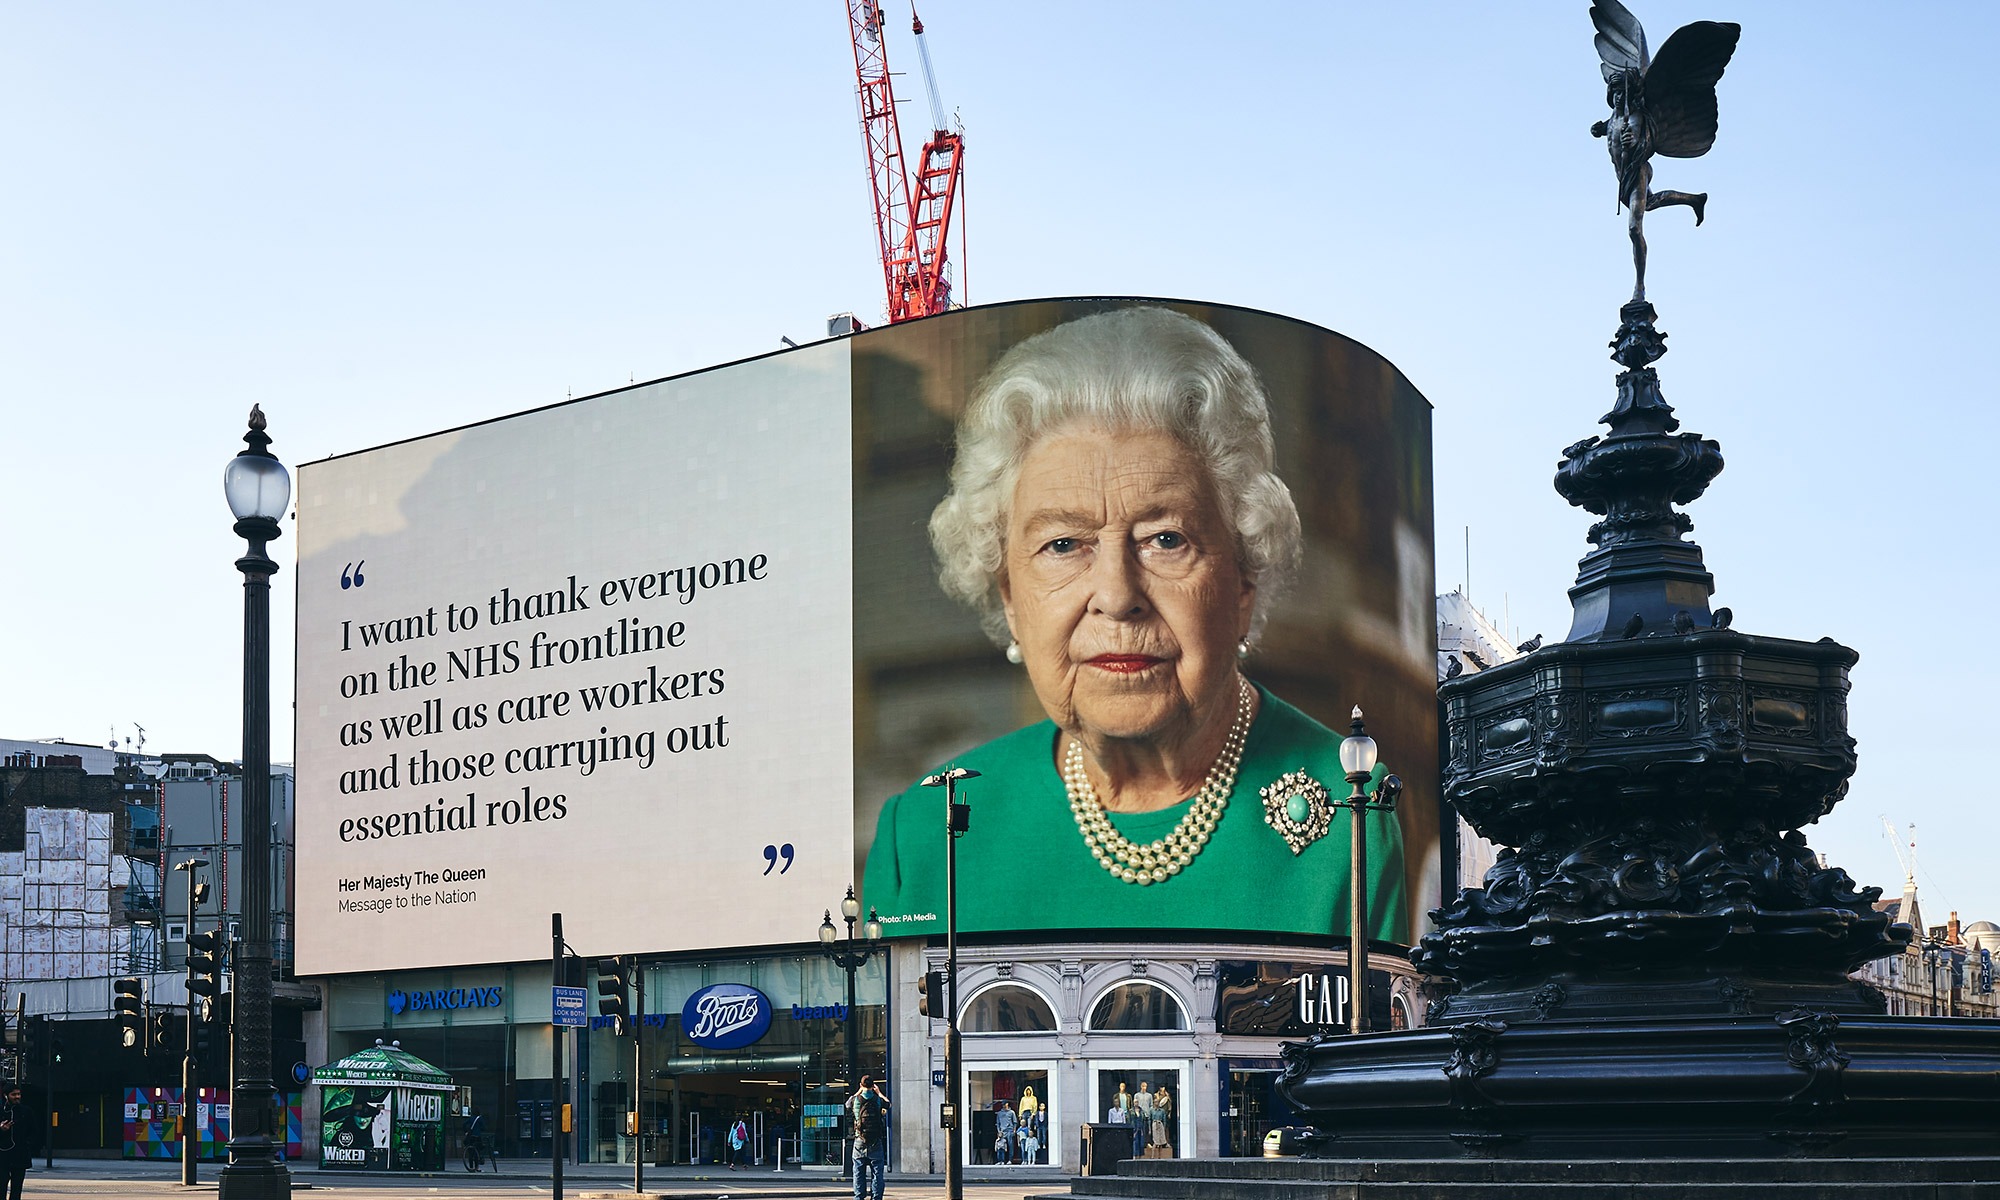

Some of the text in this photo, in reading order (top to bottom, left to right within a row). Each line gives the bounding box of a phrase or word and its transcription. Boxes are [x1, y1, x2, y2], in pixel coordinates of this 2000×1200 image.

[341, 554, 767, 651] I want to thank everyone
[341, 618, 685, 698] on the NHS frontline
[340, 666, 724, 746] as well as care workers
[340, 715, 729, 794] and those carrying out
[340, 786, 566, 842] essential roles
[339, 869, 485, 892] Her Majesty The Queen
[339, 890, 476, 913] Message to the Nation
[878, 916, 901, 924] Photo:
[914, 913, 936, 921] Media
[410, 986, 502, 1011] BARCLAYS
[690, 994, 758, 1039] Boots
[792, 1002, 848, 1021] beauty
[1300, 973, 1349, 1025] GAP
[397, 1088, 441, 1122] WICKED
[323, 1146, 365, 1161] WICKED
